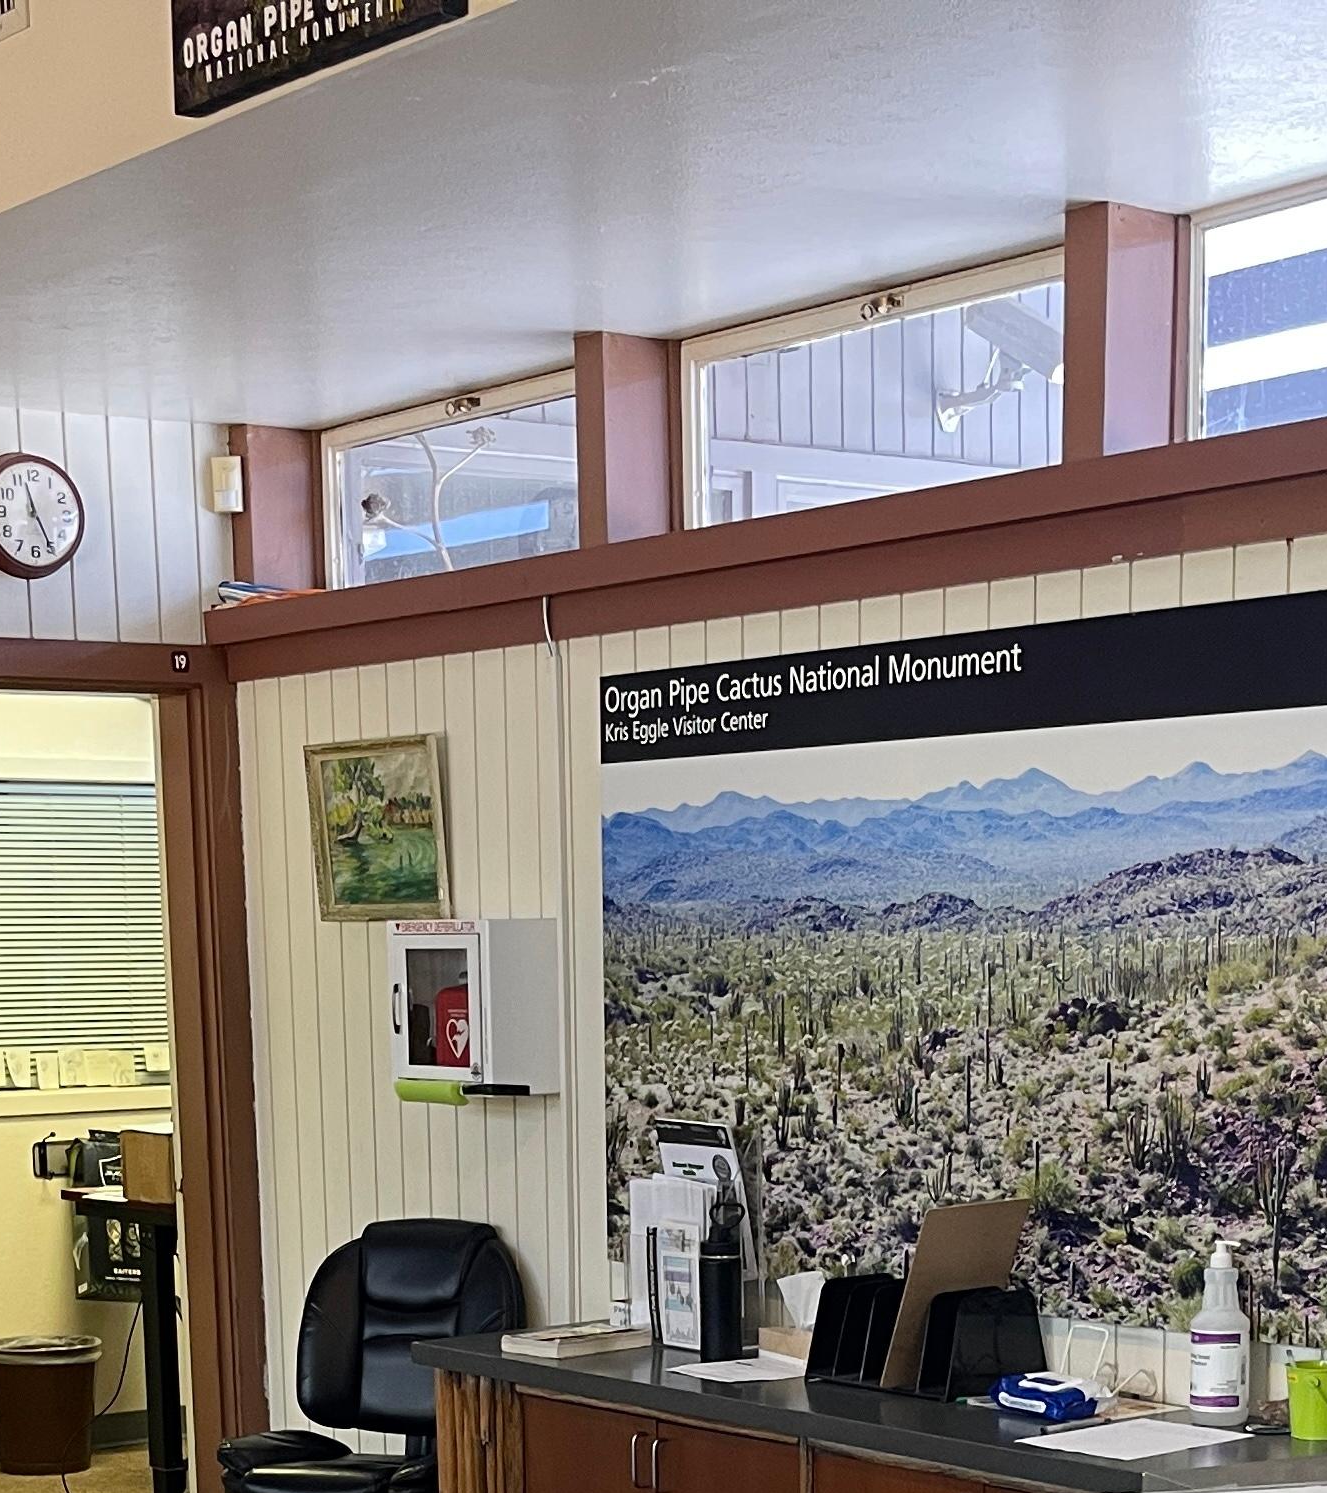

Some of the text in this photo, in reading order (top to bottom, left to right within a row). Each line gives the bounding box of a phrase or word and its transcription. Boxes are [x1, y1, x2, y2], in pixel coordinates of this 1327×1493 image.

[183, 0, 315, 68] ORGAN PIPE
[205, 36, 289, 82] NATIONAL
[13, 473, 22, 487] 11
[27, 469, 40, 482] 12
[1, 487, 14, 501] 10
[57, 492, 66, 505] 2
[2, 525, 12, 538] 8
[14, 539, 24, 552] 7
[31, 545, 41, 558] 6
[174, 654, 187, 670] 19
[604, 642, 1022, 718] Organ Pipe Cactus National Monument
[605, 711, 769, 744] Kris Eggle Visitor Center
